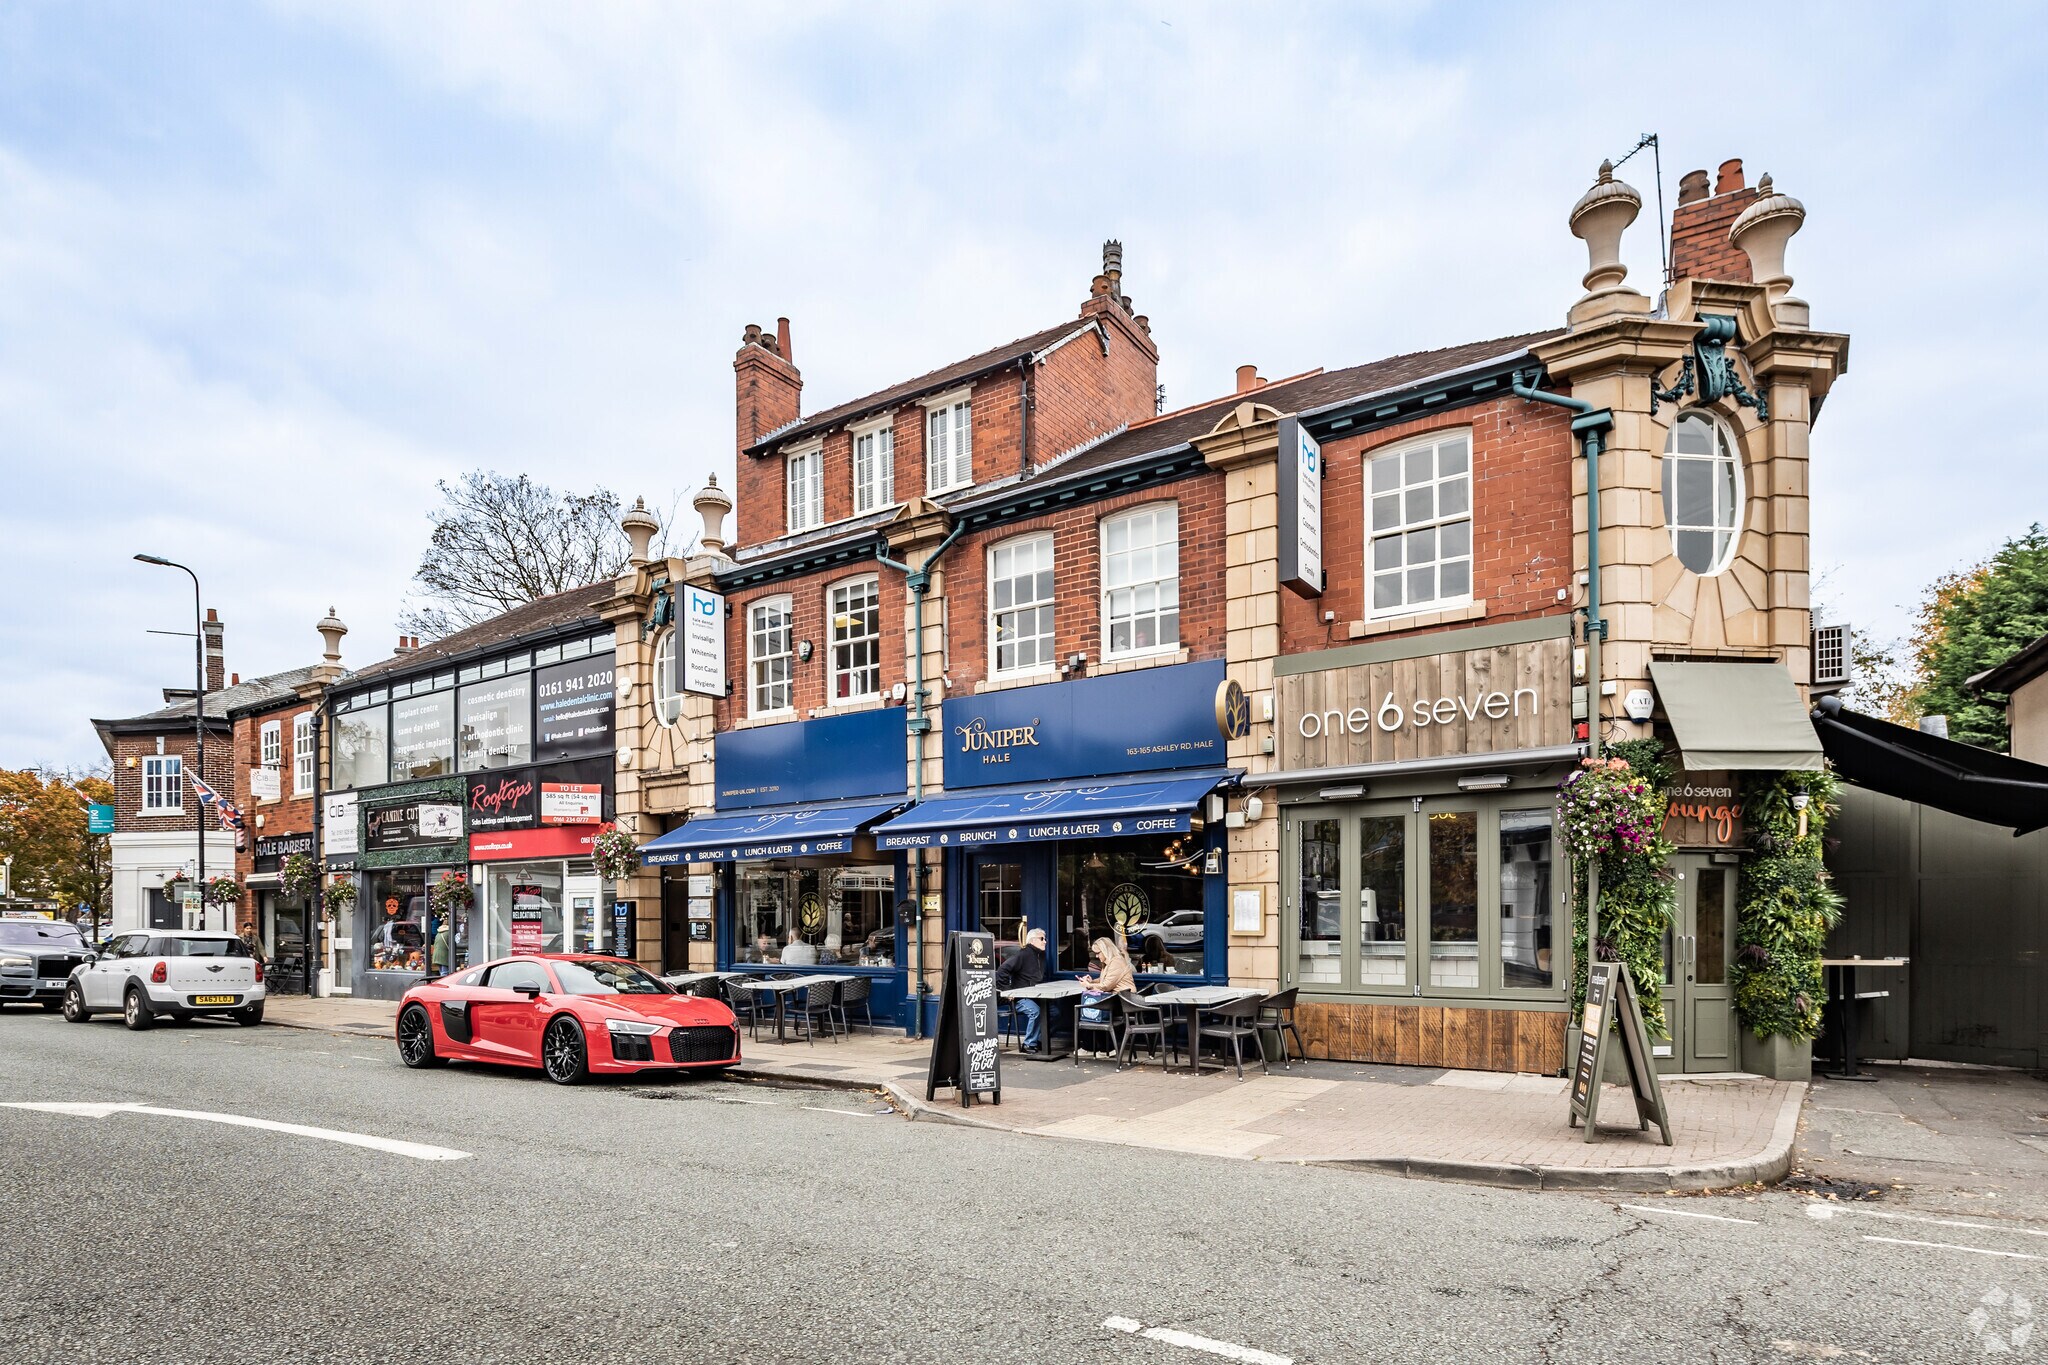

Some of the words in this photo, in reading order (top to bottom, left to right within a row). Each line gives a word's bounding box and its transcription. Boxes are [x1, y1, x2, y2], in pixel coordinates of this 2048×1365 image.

[1302, 495, 1316, 513] Implants
[1300, 537, 1320, 560] Orthodontics
[1304, 563, 1315, 579] Family
[692, 633, 716, 644] Invisalign
[691, 648, 717, 659] Whitening
[691, 663, 704, 672] Root
[704, 665, 718, 674] Canal
[539, 681, 562, 698] 0161
[565, 676, 584, 692] 941
[587, 670, 613, 688] 2020
[695, 679, 716, 690] Hygiene
[467, 692, 495, 705] cosmetic
[496, 687, 525, 699] dentistry
[398, 708, 419, 719] implant
[421, 704, 439, 715] centre
[467, 710, 498, 723] invisalign
[1299, 707, 1370, 738] one
[1377, 691, 1404, 732] 6
[1412, 688, 1538, 727] seven
[398, 728, 412, 736] same
[413, 724, 423, 733] day
[425, 720, 440, 730] teeth
[467, 727, 504, 741] orthodontic
[505, 723, 524, 735] clinic
[426, 737, 451, 749] implants
[1126, 747, 1151, 756] 163-165
[1151, 743, 1179, 753] ASHLEY
[1193, 739, 1214, 749] HALE
[467, 748, 487, 759] family
[488, 744, 518, 756] dentistry
[982, 752, 1011, 764] HALE
[398, 761, 405, 770] CT
[406, 758, 431, 769] scanning
[471, 778, 534, 815] Rooftops
[545, 792, 557, 800] 585
[571, 793, 581, 801] (54
[559, 785, 570, 793] TO
[570, 785, 584, 793] LET
[1683, 782, 1694, 797] 6
[1694, 787, 1732, 797] seven
[329, 804, 345, 818] CIB
[381, 809, 404, 823] CANINE
[1660, 801, 1743, 842] ounge
[886, 835, 931, 846] BREAKFAST
[960, 831, 997, 842] BRUNCH
[1029, 826, 1060, 837] LUNCH
[1062, 825, 1069, 835] &
[1071, 824, 1100, 835] LATER
[1136, 818, 1176, 830] COFFEE
[255, 842, 277, 857] HALE
[648, 854, 679, 863] BREAKFAST
[699, 851, 723, 860] BRUNCH
[745, 847, 767, 856] LUNCH
[767, 846, 773, 854] &
[773, 845, 792, 854] LATER
[816, 841, 843, 851] COFFEE
[512, 911, 535, 919] RELOCATING
[964, 977, 993, 996] JUNIPER
[966, 987, 992, 1006] COFFEE
[967, 1041, 984, 1055] GRAB
[983, 1038, 998, 1049] YOUR
[970, 1061, 980, 1072] TO
[981, 1053, 996, 1070] GO!
[971, 1048, 994, 1063] COFFEE
